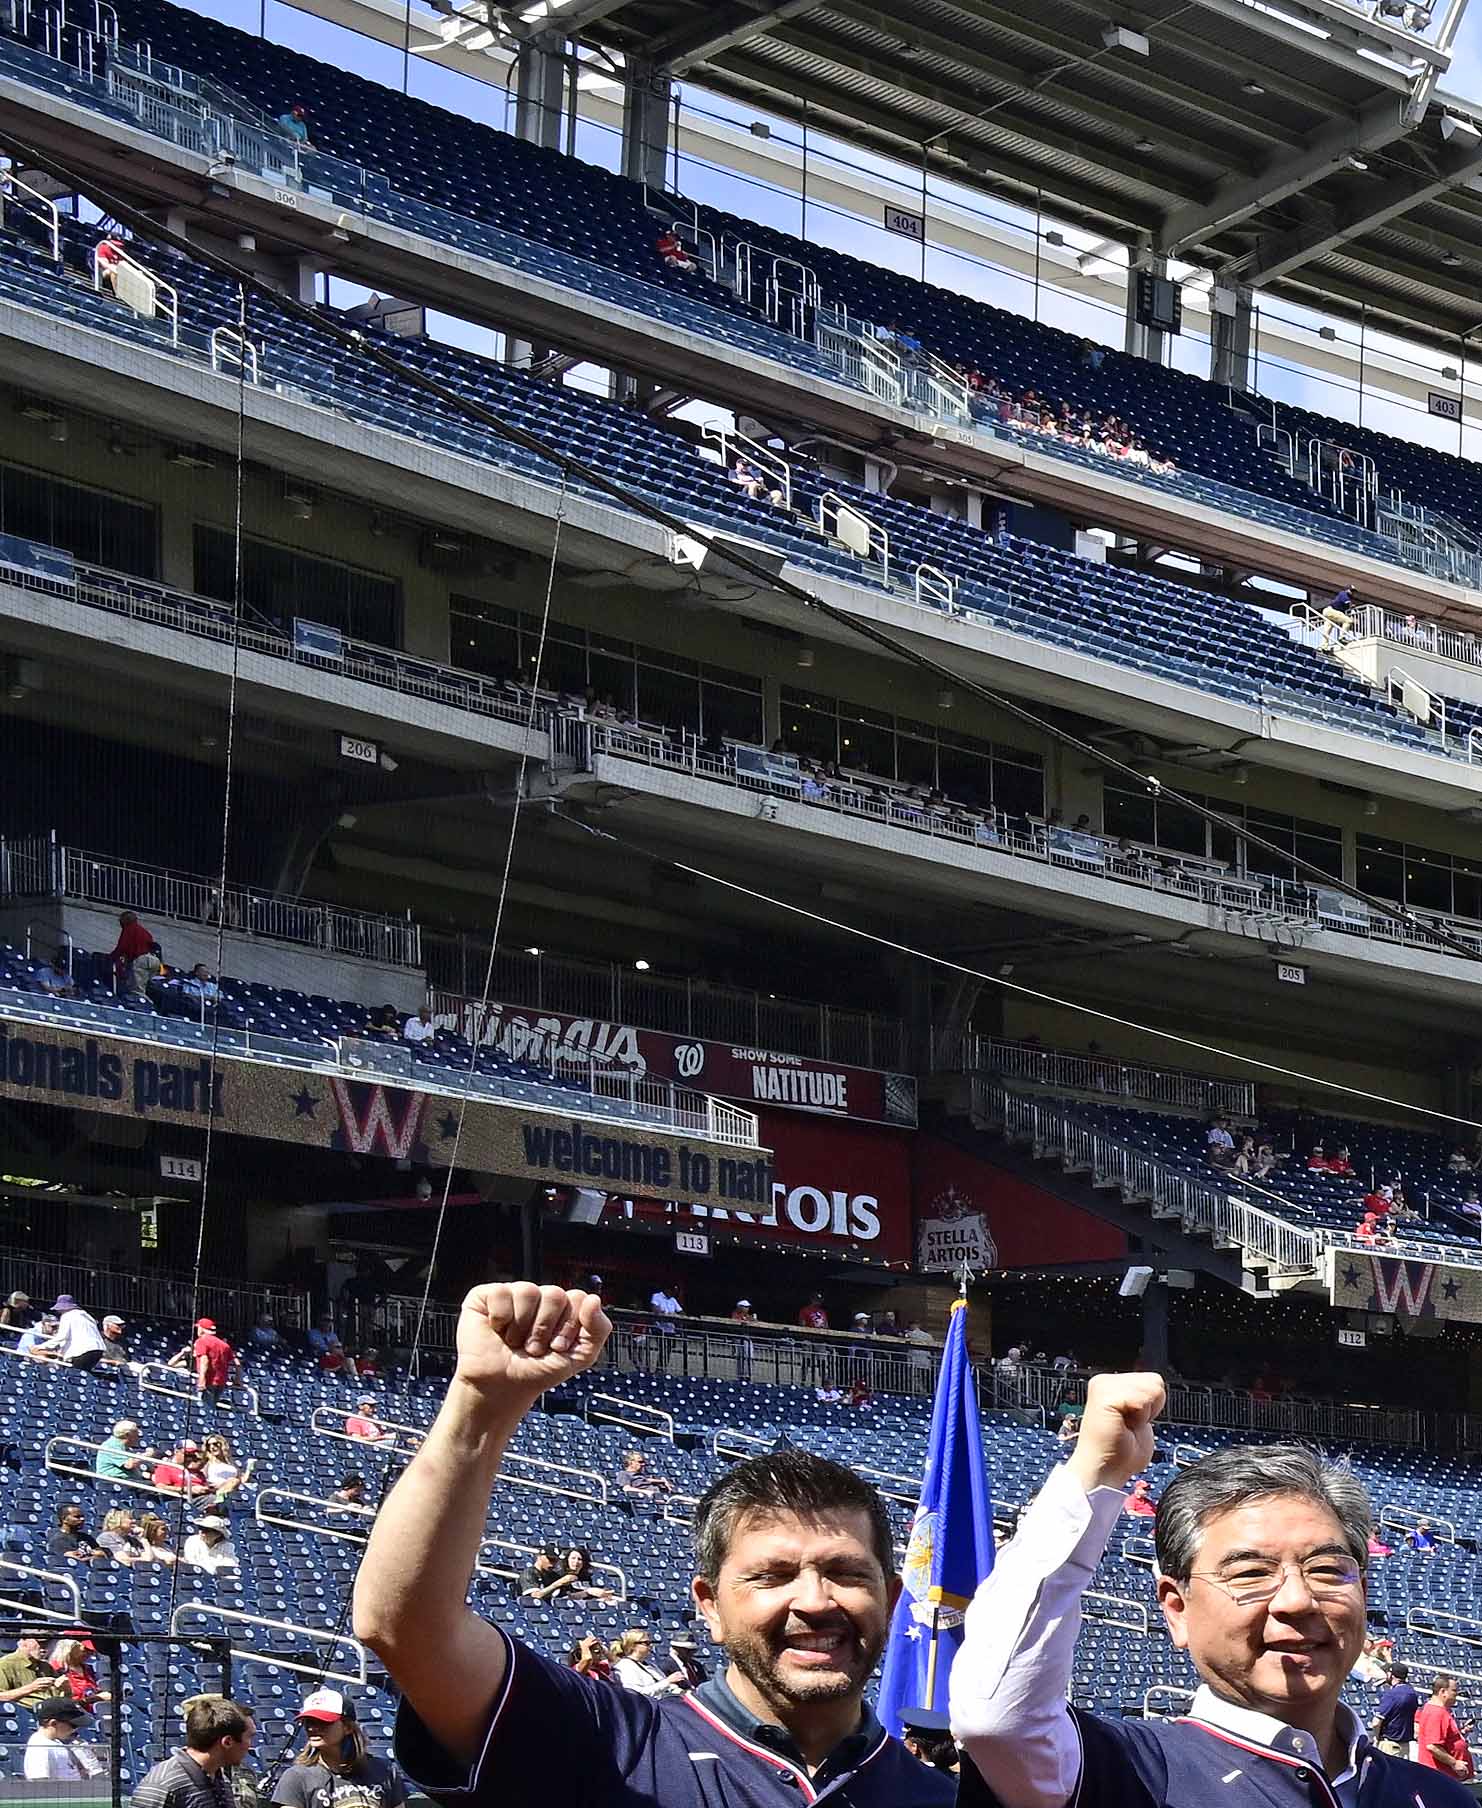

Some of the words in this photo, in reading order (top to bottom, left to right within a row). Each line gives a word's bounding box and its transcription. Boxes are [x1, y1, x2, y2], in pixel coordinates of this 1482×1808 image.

[276, 191, 295, 205] 306
[893, 215, 917, 234] 404
[1435, 400, 1455, 415] 403
[346, 741, 371, 758] 206
[1282, 968, 1300, 980] 205
[731, 1048, 767, 1062] SHOW
[769, 1053, 802, 1066] SOME
[133, 1057, 225, 1117] park
[752, 1066, 848, 1108] NATITUDE
[521, 1124, 671, 1188] welcome
[679, 1145, 711, 1194] to
[167, 1160, 196, 1177] 114
[682, 1235, 704, 1250] 113
[927, 1228, 979, 1246] STELLA
[926, 1245, 980, 1264] ARTOIS
[1343, 1332, 1361, 1344] 112
